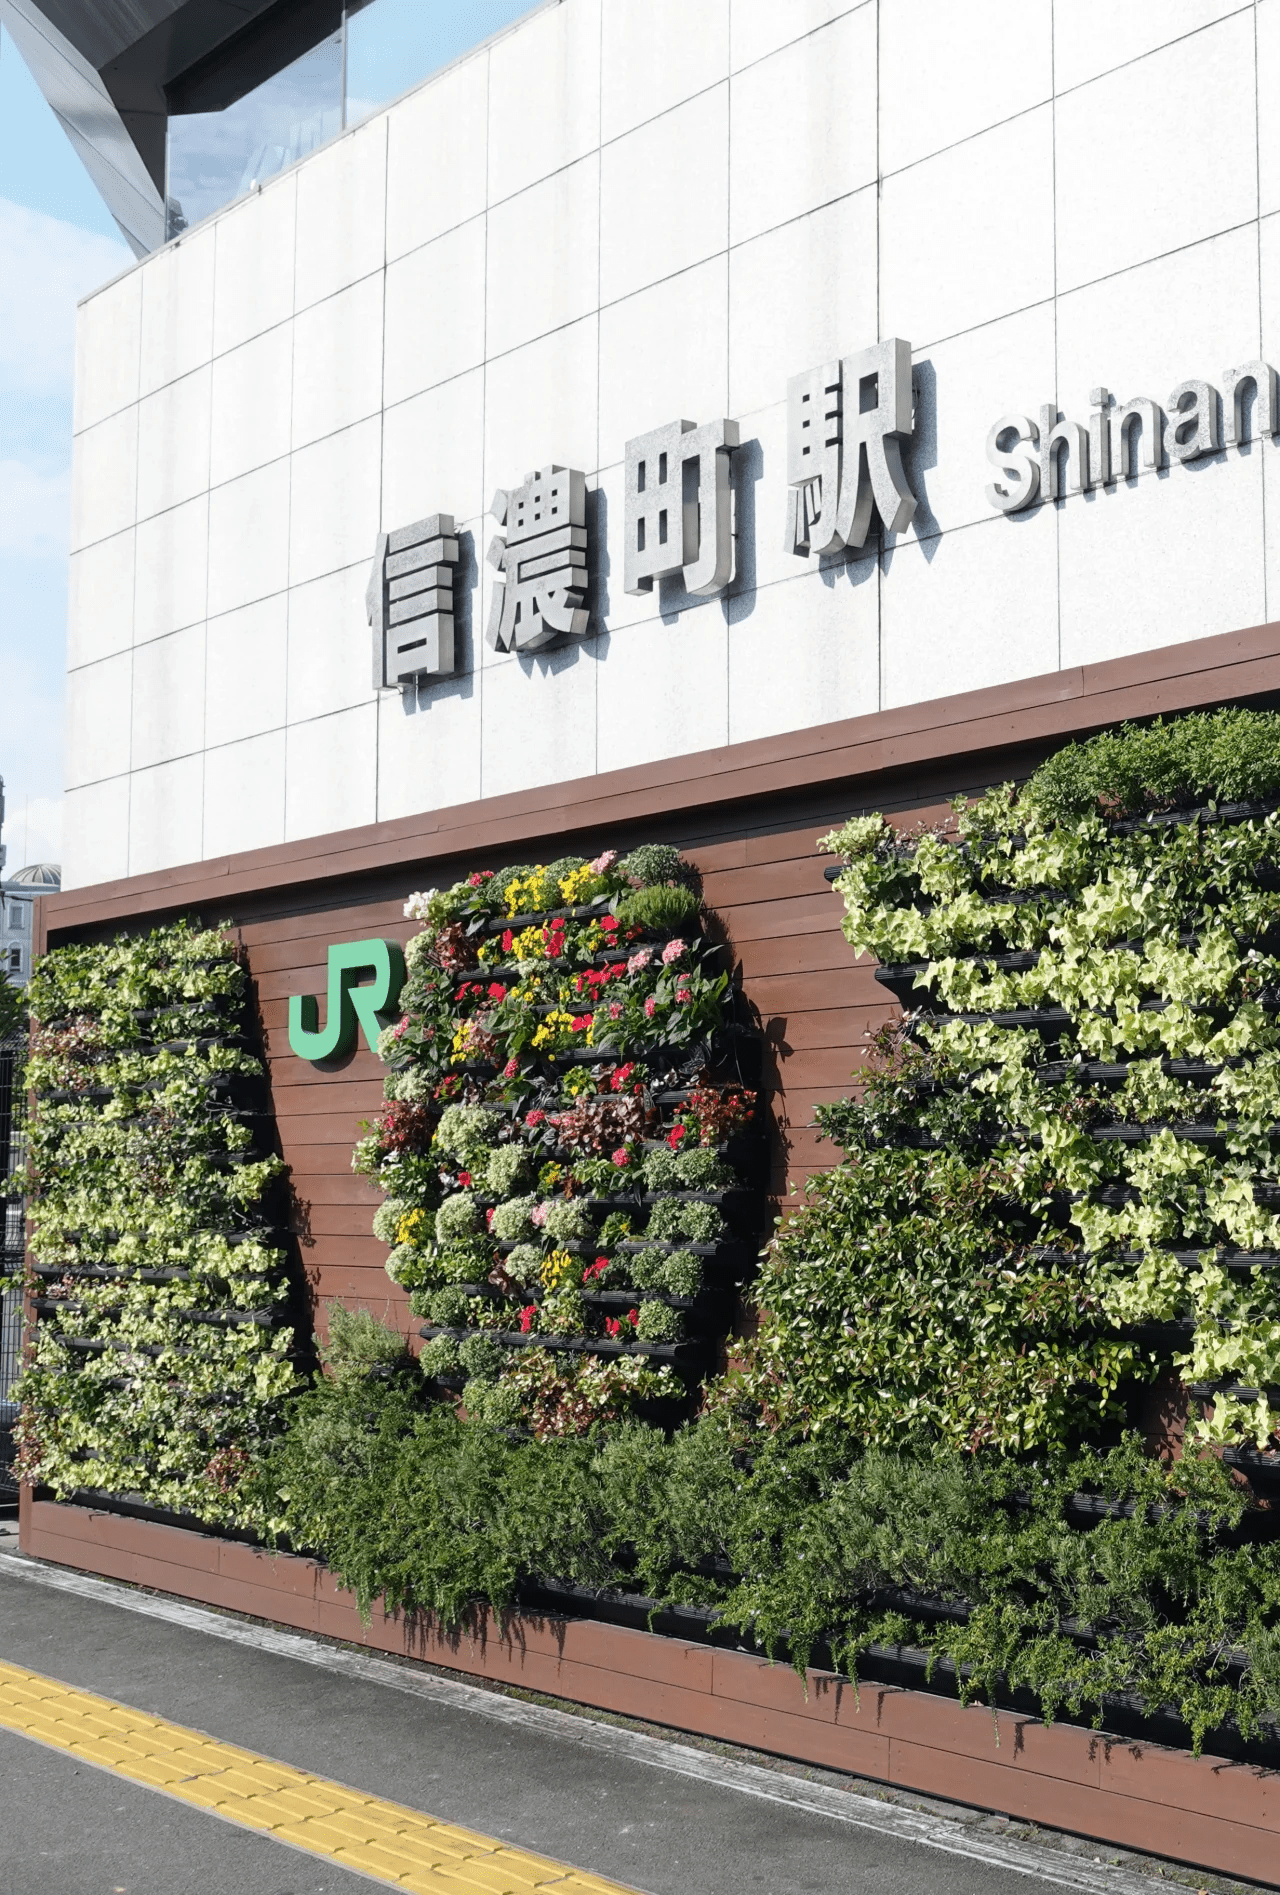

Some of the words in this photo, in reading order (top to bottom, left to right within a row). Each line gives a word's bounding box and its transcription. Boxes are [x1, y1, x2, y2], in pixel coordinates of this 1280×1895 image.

[366, 336, 919, 692] 信濃町駅
[288, 937, 400, 1062] JR
